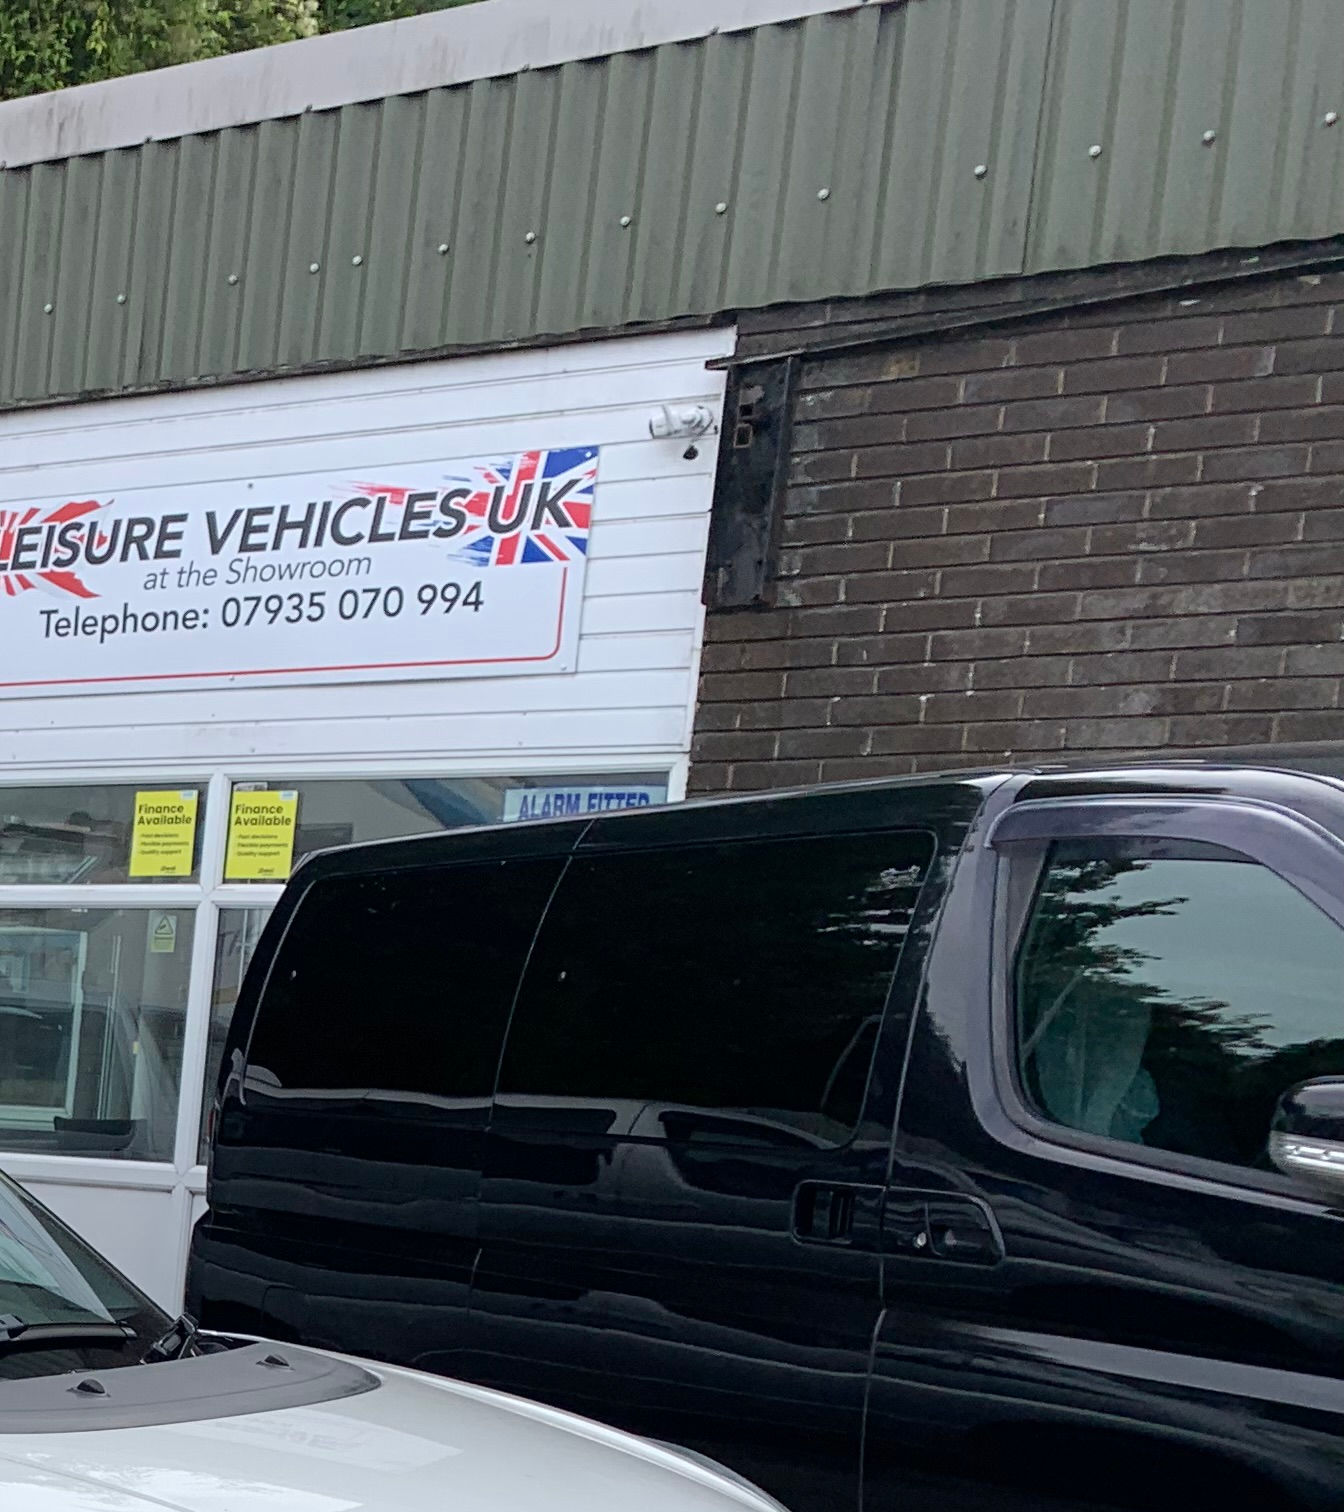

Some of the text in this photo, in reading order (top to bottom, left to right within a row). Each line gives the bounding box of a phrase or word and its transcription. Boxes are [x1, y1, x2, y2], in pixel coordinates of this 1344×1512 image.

[205, 487, 470, 556] VEHICLES
[485, 477, 582, 533] UK
[143, 553, 372, 591] at the Showroom
[39, 581, 484, 643] Telephone: 07935 070 994
[138, 803, 185, 814] Finance
[235, 803, 284, 815] Finance
[518, 792, 650, 820] ALARM FITTED
[137, 814, 192, 826] Available
[234, 815, 292, 826] Available
